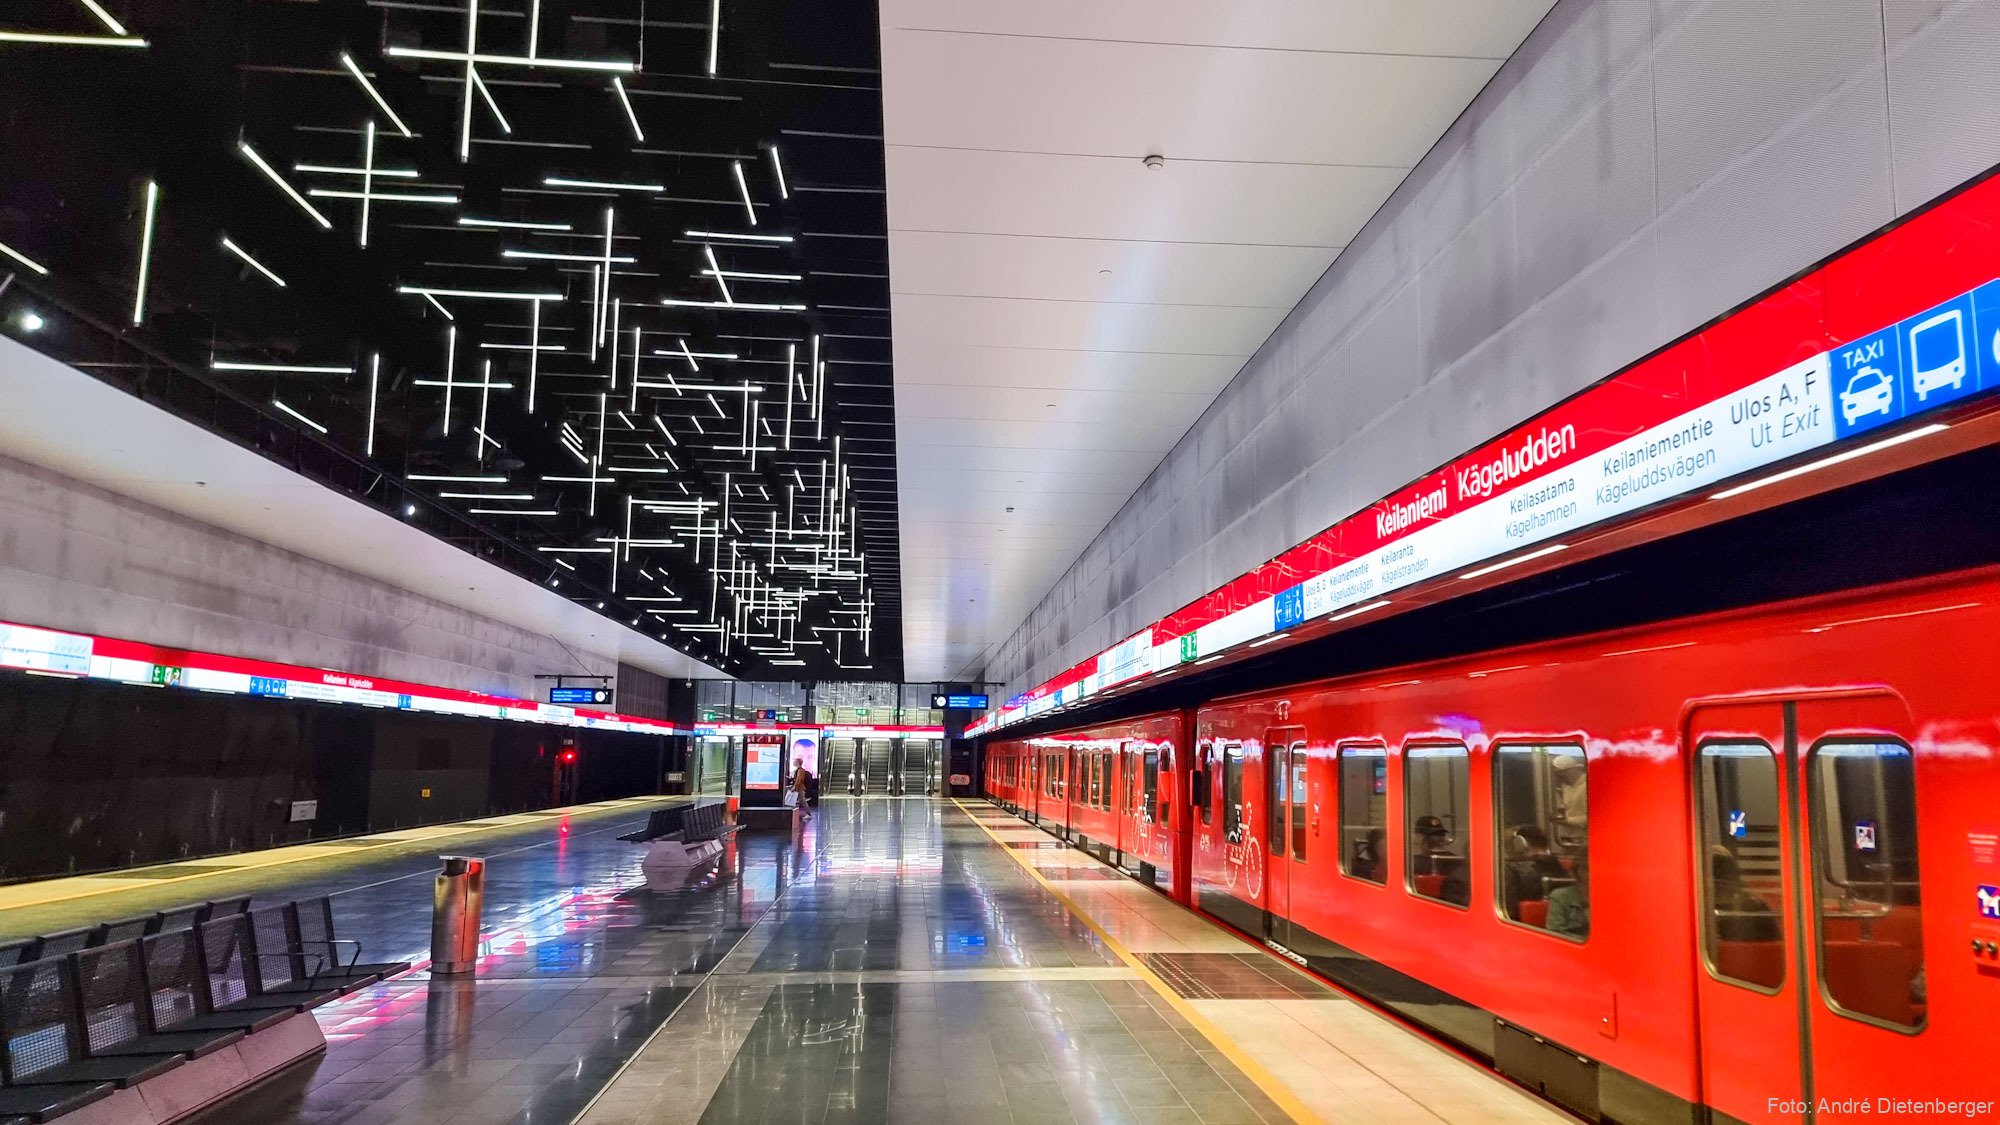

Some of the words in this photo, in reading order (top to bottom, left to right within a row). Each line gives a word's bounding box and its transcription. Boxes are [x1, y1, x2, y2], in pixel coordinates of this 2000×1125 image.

[1842, 339, 1884, 369] TAXI
[1731, 395, 1771, 425] Ulos
[1778, 382, 1799, 407] A,
[1805, 370, 1816, 395] F
[1751, 422, 1773, 448] Ut
[1782, 404, 1820, 438] Exit
[1603, 419, 1713, 478] Keilaniementie
[1376, 479, 1447, 539] Keilaniemi
[1457, 423, 1576, 501] Kägeludden
[1510, 477, 1575, 515] Keilasatama
[1596, 448, 1716, 506] Kägeluddsvägen
[1505, 501, 1577, 539] Kägelhamnen
[1381, 544, 1414, 566] Keilaranta
[1381, 558, 1429, 584] Kägelstranden
